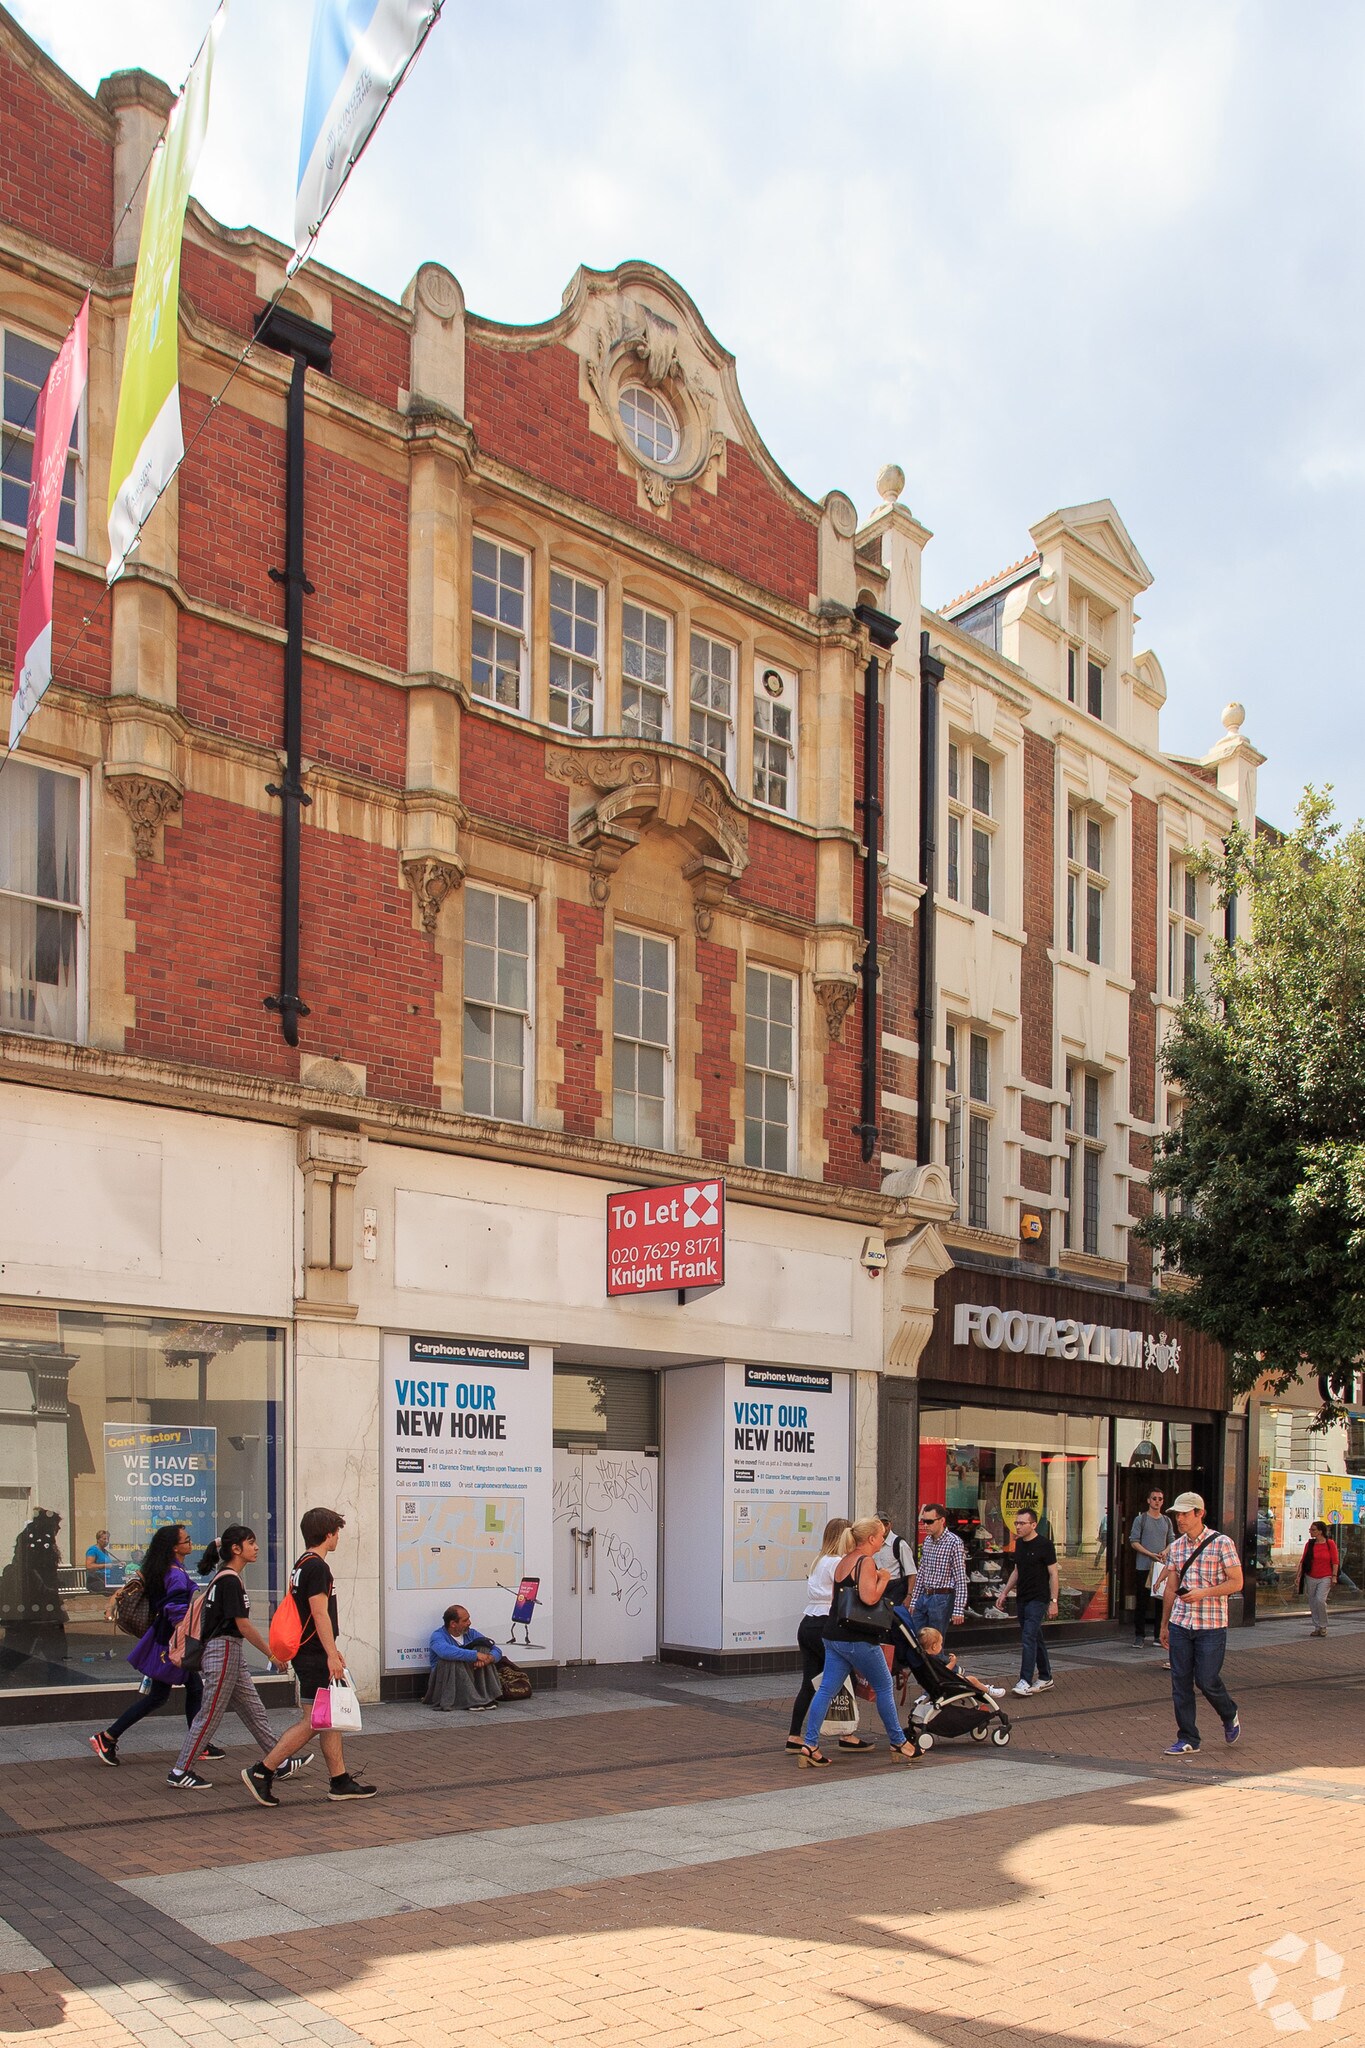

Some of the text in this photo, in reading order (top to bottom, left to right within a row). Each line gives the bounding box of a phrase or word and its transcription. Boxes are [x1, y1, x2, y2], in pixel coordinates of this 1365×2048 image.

[612, 1199, 680, 1230] To Let
[612, 1237, 719, 1264] 020 7629 8171
[612, 1257, 717, 1288] Knight Frank
[415, 1342, 525, 1360] Carphone Warehouse
[748, 1370, 829, 1385] Carphone Warehouse
[395, 1380, 496, 1410] VISIT OUR
[734, 1402, 808, 1428] VISIT OUR
[396, 1410, 506, 1440] NEW HOME
[108, 1431, 181, 1448] Card Factory
[735, 1428, 815, 1453] NEW HOME
[123, 1455, 199, 1470] WE HAVE
[476, 1465, 495, 1473] Kingston
[127, 1473, 195, 1487] CLOSED
[474, 1482, 527, 1490] carphonewarehouse.com
[1006, 1482, 1038, 1499] FINAL
[181, 1496, 207, 1504] Factory
[1006, 1500, 1038, 1508] REDUCTIONS
[831, 1696, 849, 1705] M&S
